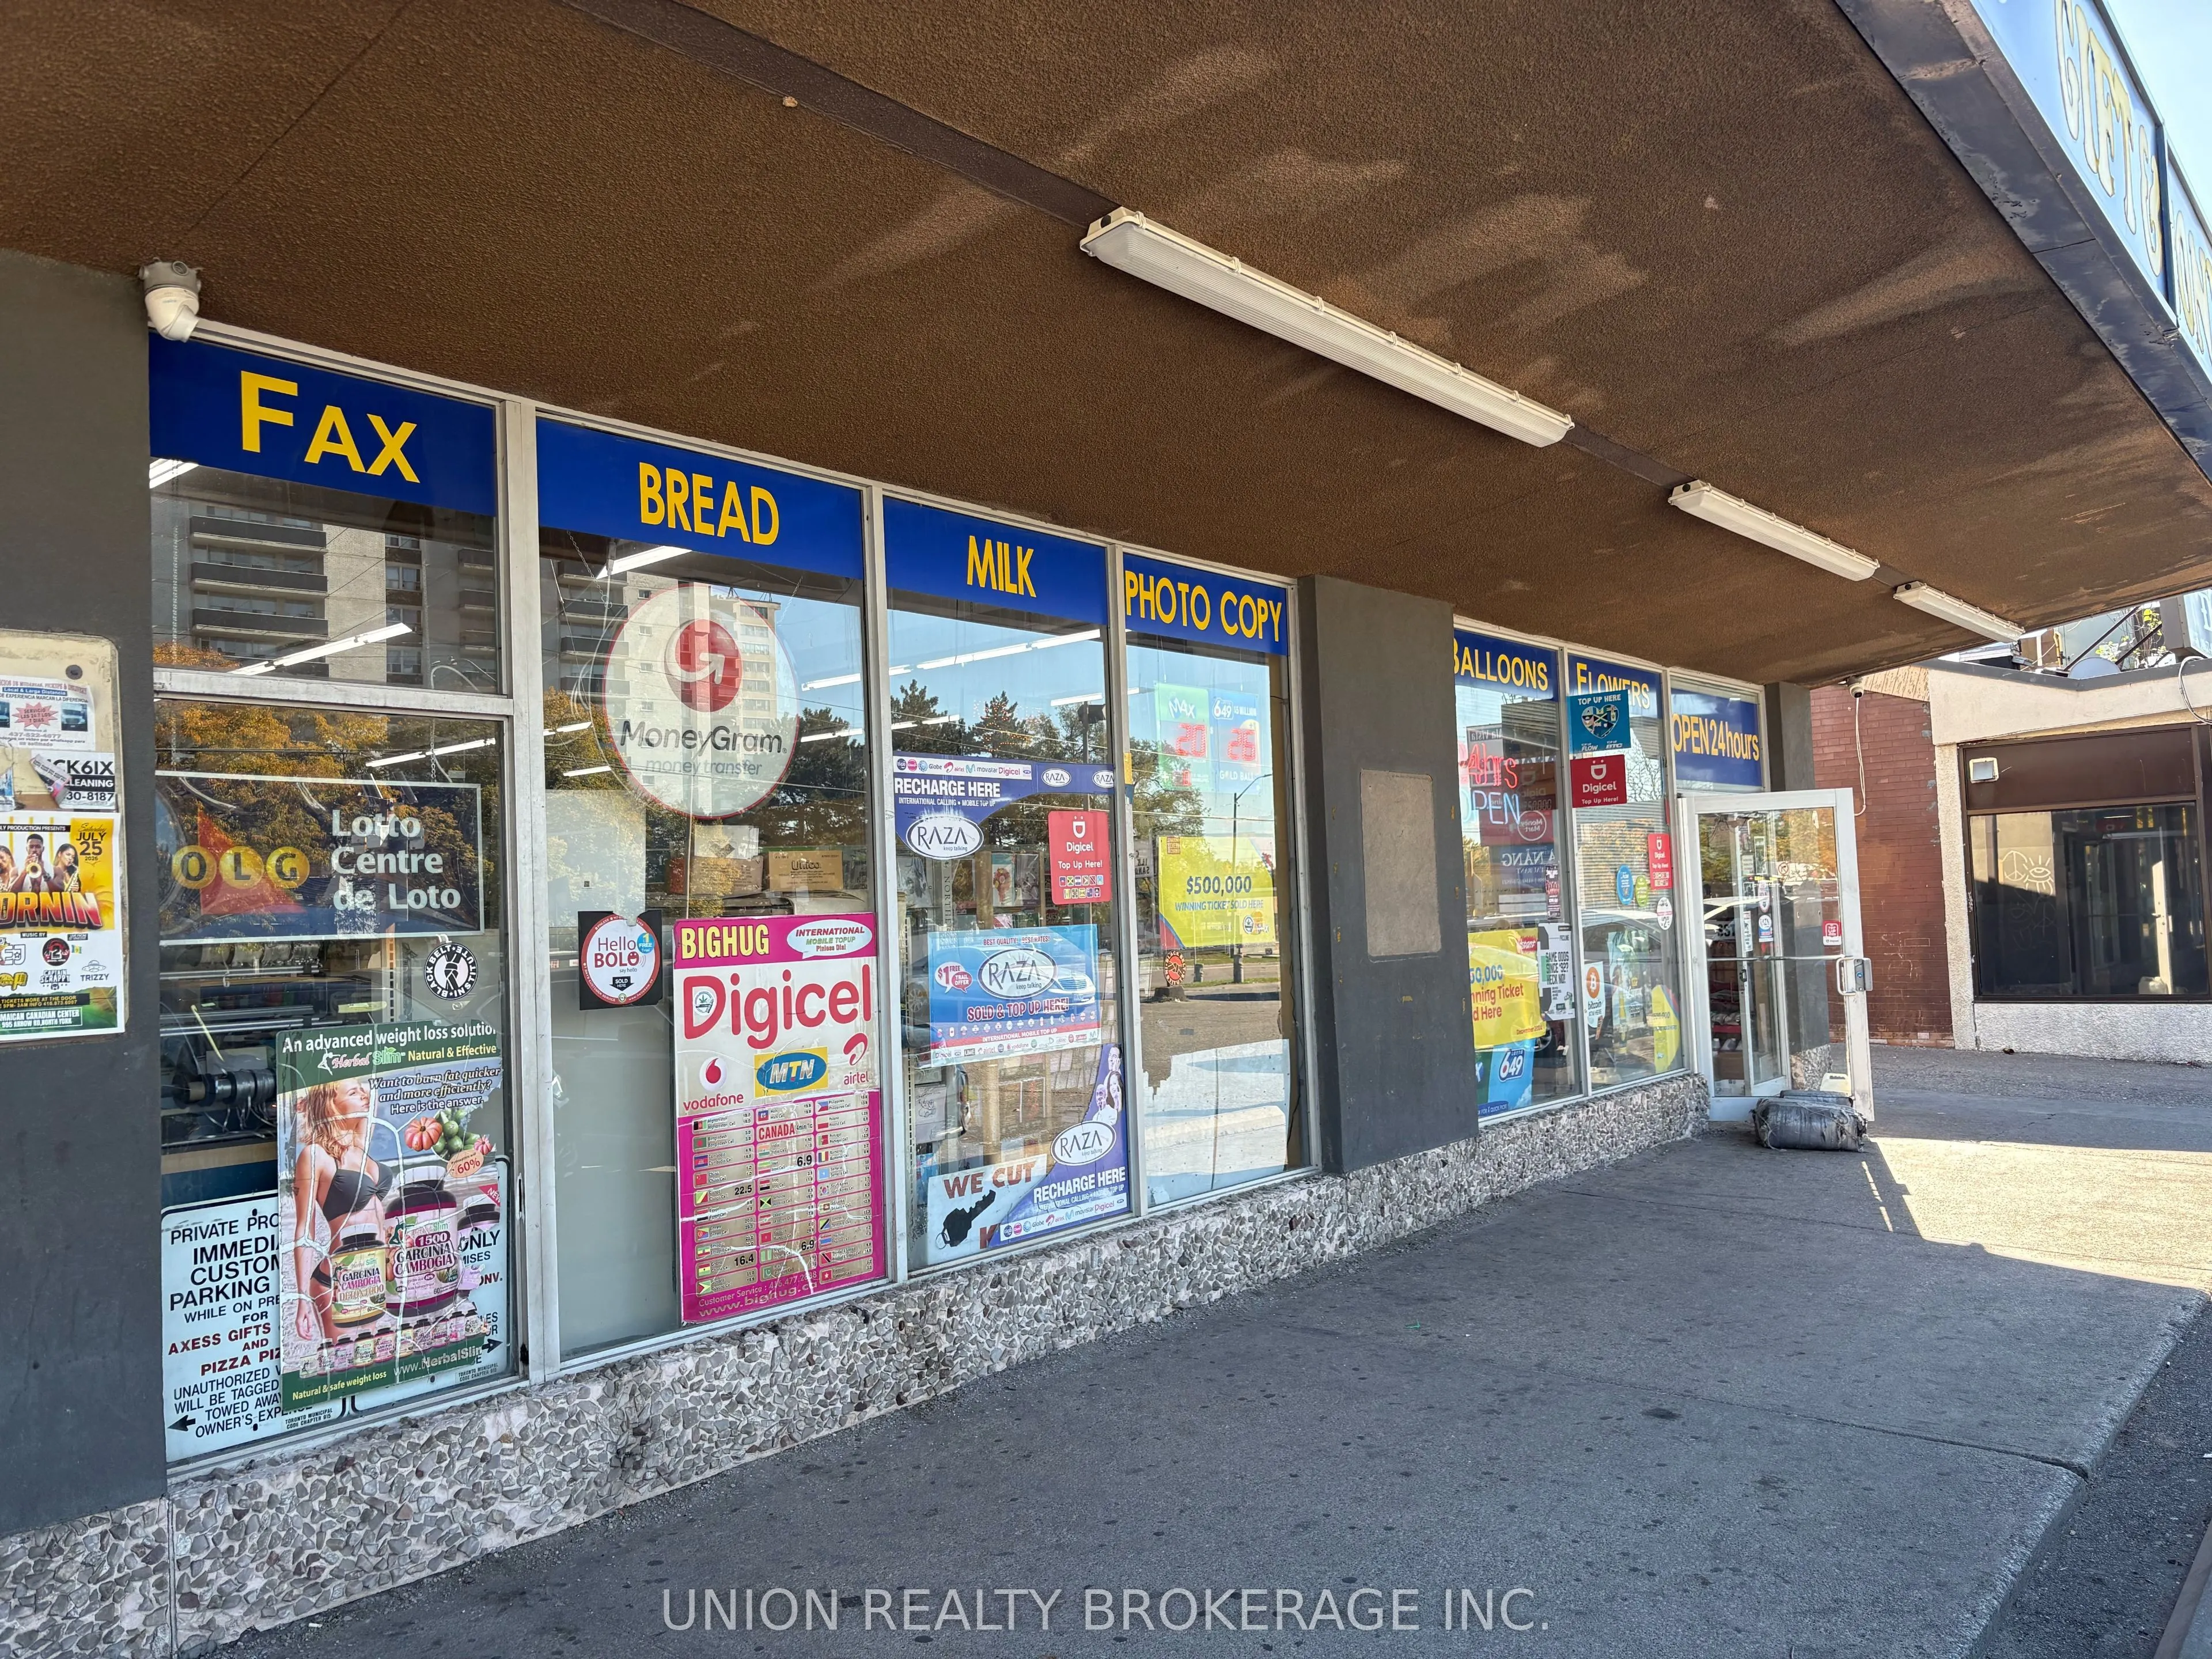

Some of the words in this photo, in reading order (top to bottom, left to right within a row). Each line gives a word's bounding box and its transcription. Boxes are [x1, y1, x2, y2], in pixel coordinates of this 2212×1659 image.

[241, 370, 420, 483] FAX
[639, 462, 779, 546] BREAD
[967, 535, 1036, 598] MILK
[1125, 570, 1210, 631] PHOTO
[1220, 590, 1282, 642] COPY
[1168, 698, 1196, 719] MAX
[1604, 694, 1621, 702] HERE
[620, 719, 783, 757] MoneyGram
[1175, 723, 1207, 757] 20
[1228, 728, 1256, 762] 26
[1672, 713, 1709, 755] OPEN
[1710, 719, 1725, 756] 24
[1726, 725, 1759, 761] hours
[895, 778, 965, 794] RECHARGE
[968, 782, 1001, 797] HERE
[1582, 781, 1616, 794] Digicel
[332, 809, 421, 837] Lotto
[76, 832, 107, 840] JULY
[918, 827, 968, 850] RAZA
[79, 842, 103, 855] 25
[1066, 841, 1094, 855] Digicel
[180, 852, 302, 882] OLG
[330, 846, 444, 874] Centre
[1058, 861, 1071, 870] Top
[1073, 860, 1083, 869] Up
[1085, 859, 1103, 868] Here!
[333, 887, 376, 911] de
[389, 883, 461, 911] Loto
[1187, 876, 1252, 897] $500,000
[1175, 901, 1206, 911] WINNING
[1207, 901, 1230, 910] TICKET
[1230, 900, 1247, 909] SOLD
[1249, 900, 1263, 908] HERE
[681, 923, 770, 960] BIGHUG
[796, 926, 865, 937] INTERNATIONAL
[806, 937, 833, 945] MOBILE
[429, 945, 451, 964] BELT
[599, 937, 636, 951] Hello
[594, 952, 639, 968] BOLO
[1546, 952, 1557, 963] SAME
[1558, 952, 1569, 961] ODDS
[1546, 963, 1558, 974] SINCE
[426, 966, 448, 997] BLACK
[454, 946, 476, 997] INSTITUTE
[988, 960, 1040, 990] RAZA
[1547, 975, 1558, 985] HECK
[1498, 983, 1524, 998] Ticket
[683, 964, 872, 1050] Digicel
[967, 1005, 994, 1022] SOLD
[997, 1004, 1004, 1017] &
[1007, 1002, 1026, 1016] TOP
[1028, 1001, 1040, 1015] UP
[1043, 997, 1070, 1013] HERE!
[1588, 1000, 1602, 1009] bitcoin
[283, 1038, 302, 1053] An
[306, 1030, 372, 1052] advanced
[376, 1027, 421, 1047] weight
[425, 1025, 448, 1040] loss
[770, 1058, 815, 1085] MTN
[1500, 1051, 1523, 1077] 649
[369, 1078, 399, 1090] Want
[402, 1077, 414, 1086] to
[416, 1074, 442, 1084] burn
[444, 1070, 460, 1082] fat
[461, 1067, 501, 1081] quicker
[843, 1070, 869, 1086] airtel
[379, 1090, 401, 1103] and
[403, 1088, 432, 1100] more
[434, 1080, 492, 1096] efficiently?
[683, 1091, 744, 1111] vodafone
[391, 1103, 415, 1115] Here
[417, 1102, 426, 1111] is
[427, 1099, 446, 1110] the
[447, 1096, 483, 1108] answer.
[759, 1123, 795, 1140] CANADA
[1060, 1130, 1103, 1158] RAZA
[797, 1155, 812, 1166] 6.9
[735, 1185, 752, 1196] 22.5
[944, 1172, 983, 1199] WE
[993, 1161, 1036, 1188] CUT
[1034, 1174, 1095, 1203] RECHARGE
[1098, 1166, 1126, 1187] HERE
[171, 1219, 238, 1245] PRIVATE
[194, 1234, 279, 1265] IMMEDI
[801, 1240, 815, 1251] 6.9
[734, 1253, 754, 1267] 16.4
[341, 1275, 381, 1290] CAMBOGIA
[343, 1267, 380, 1282] GARCINIA
[170, 1276, 270, 1311] PARKING
[699, 1293, 735, 1307] Customer
[737, 1286, 762, 1297] Service
[184, 1305, 226, 1323] WHILE
[233, 1300, 252, 1313] ON
[243, 1311, 268, 1324] FOR
[168, 1334, 221, 1355] AXESS
[228, 1322, 271, 1342] GIFTS
[243, 1338, 269, 1351] AND
[201, 1355, 251, 1376] PIZZA
[173, 1368, 270, 1400] UNAUTHORIZED
[292, 1385, 320, 1401] Natural
[323, 1384, 328, 1393] &
[329, 1381, 346, 1391] safe
[346, 1374, 372, 1389] weight
[373, 1370, 387, 1381] loss
[175, 1400, 204, 1414] WILL
[209, 1394, 225, 1406] BE
[231, 1379, 279, 1400] TAGGED
[205, 1401, 249, 1421] TOWED
[196, 1413, 253, 1438] OWNER'S
